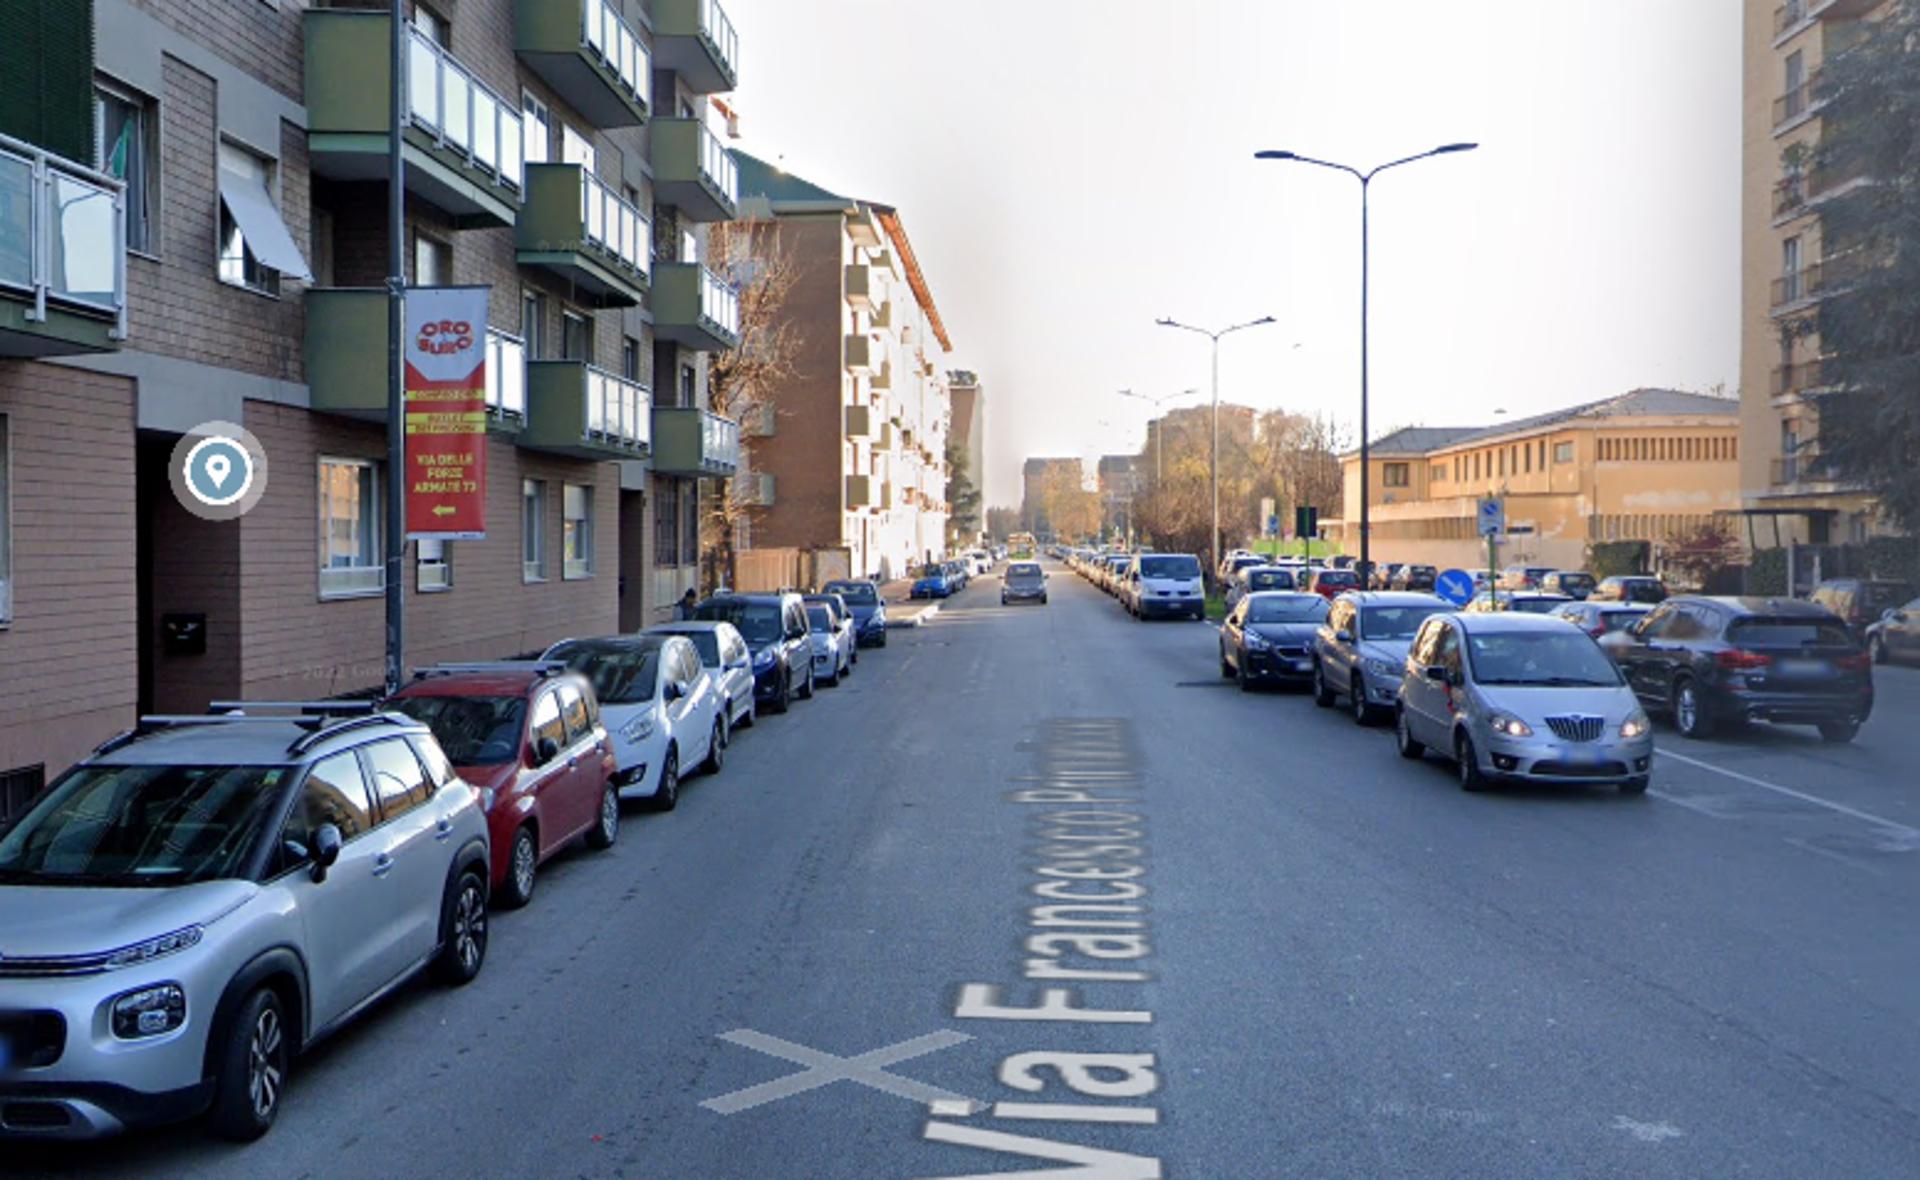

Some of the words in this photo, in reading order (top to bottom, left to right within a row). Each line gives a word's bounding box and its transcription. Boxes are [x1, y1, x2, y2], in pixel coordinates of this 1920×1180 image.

[421, 320, 470, 336] ORO
[416, 453, 436, 466] VIA
[437, 452, 474, 466] DELLE
[427, 467, 463, 479] FORZE
[413, 480, 461, 493] ARMATE
